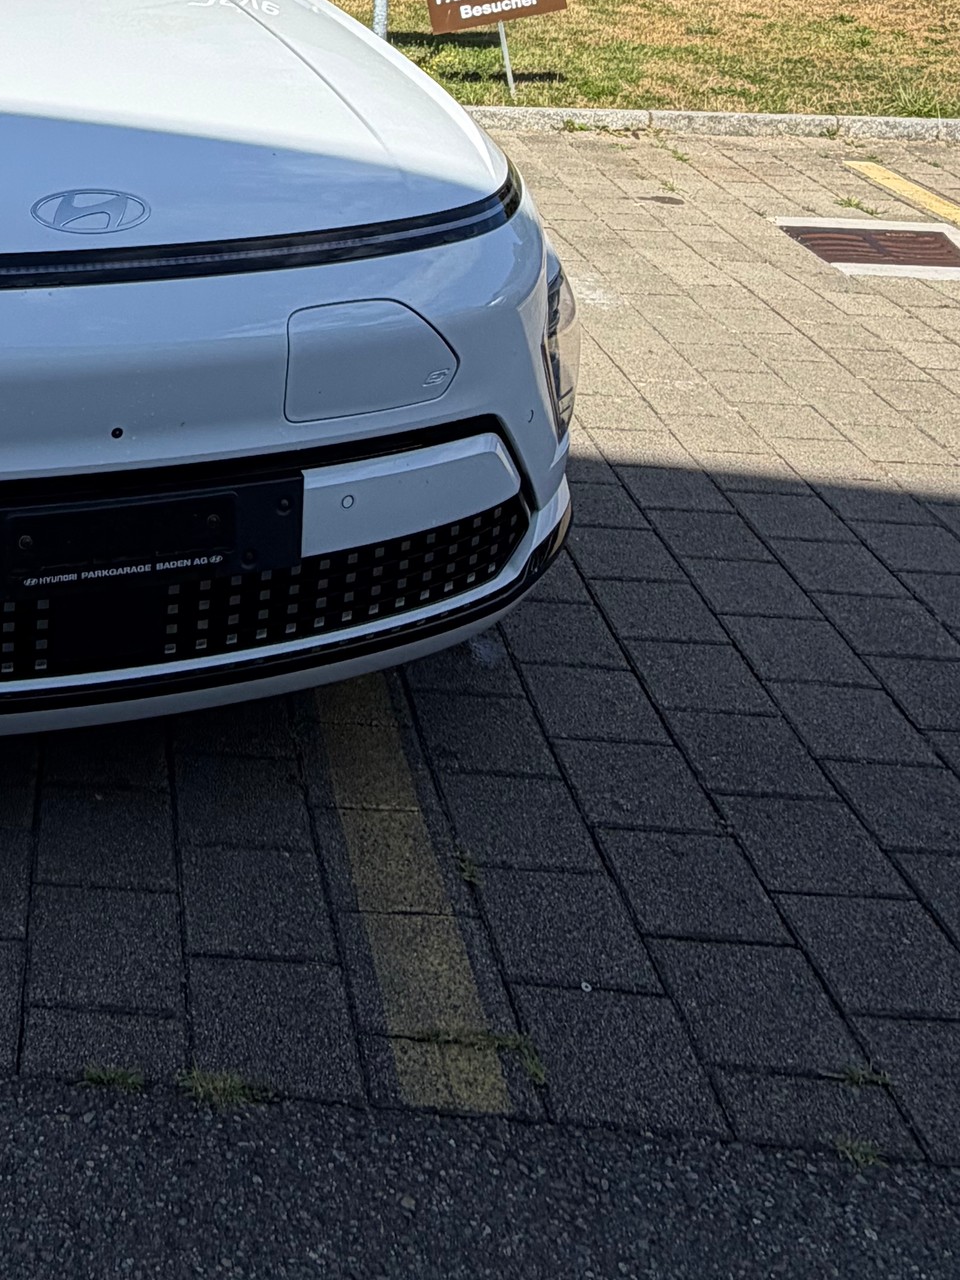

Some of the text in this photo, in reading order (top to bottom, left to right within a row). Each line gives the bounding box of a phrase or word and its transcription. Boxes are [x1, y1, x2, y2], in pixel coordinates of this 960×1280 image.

[81, 564, 152, 580] PARKGARAGE
[155, 559, 192, 571] BADEN
[193, 556, 209, 566] AG
